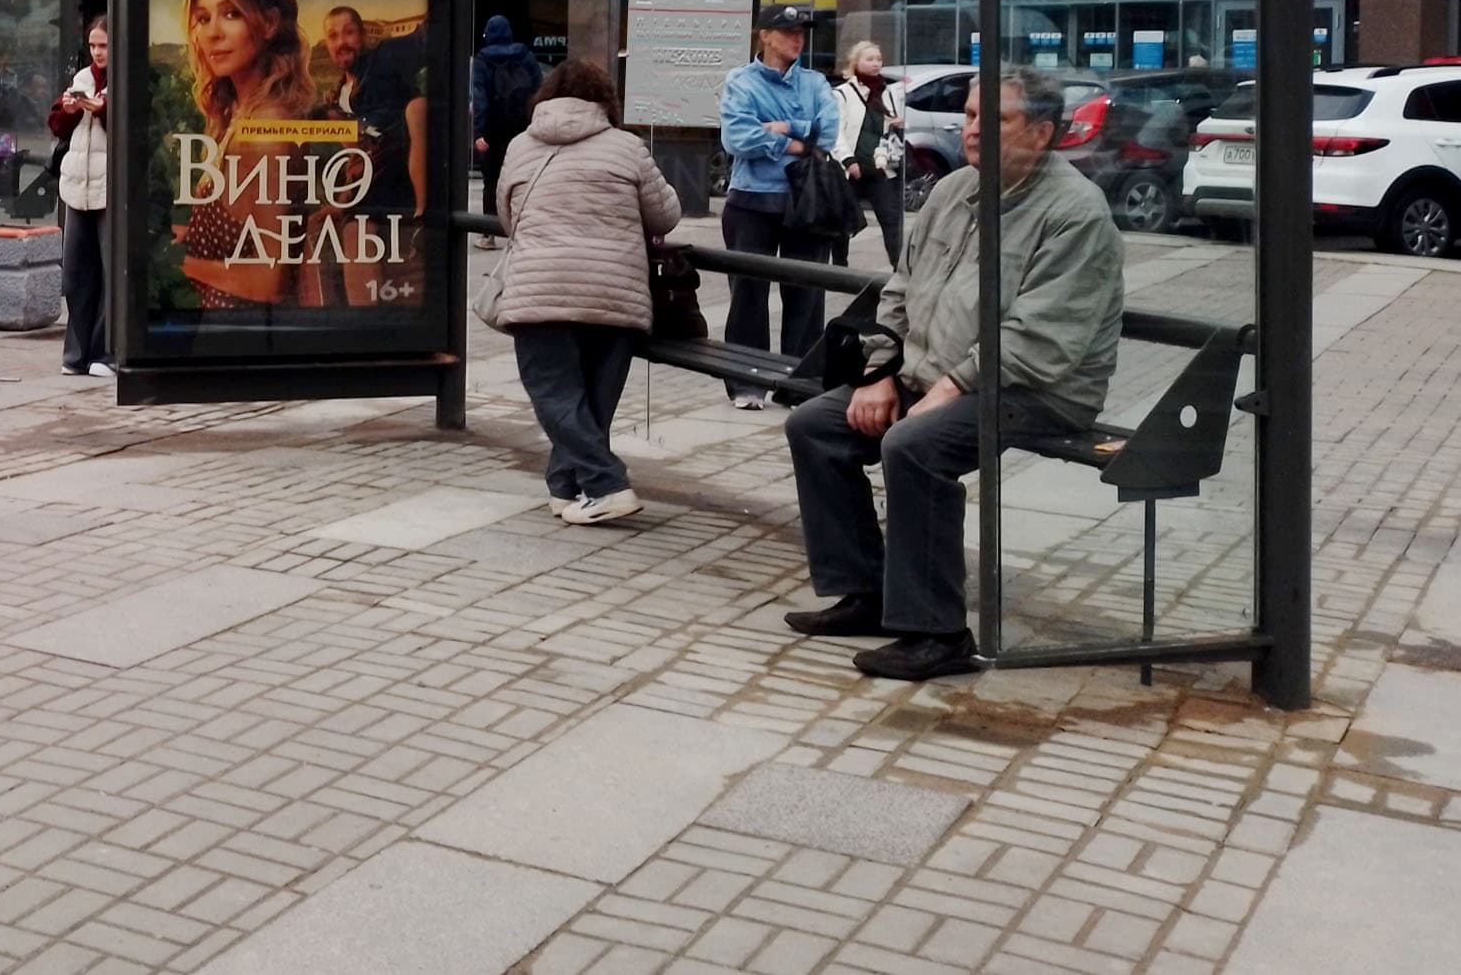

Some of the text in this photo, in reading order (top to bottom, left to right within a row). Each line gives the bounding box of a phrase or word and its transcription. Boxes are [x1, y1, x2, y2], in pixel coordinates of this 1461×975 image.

[241, 125, 353, 137] ПРЕМЬЕРА СЕРИАЛА
[366, 278, 415, 302] 16+
